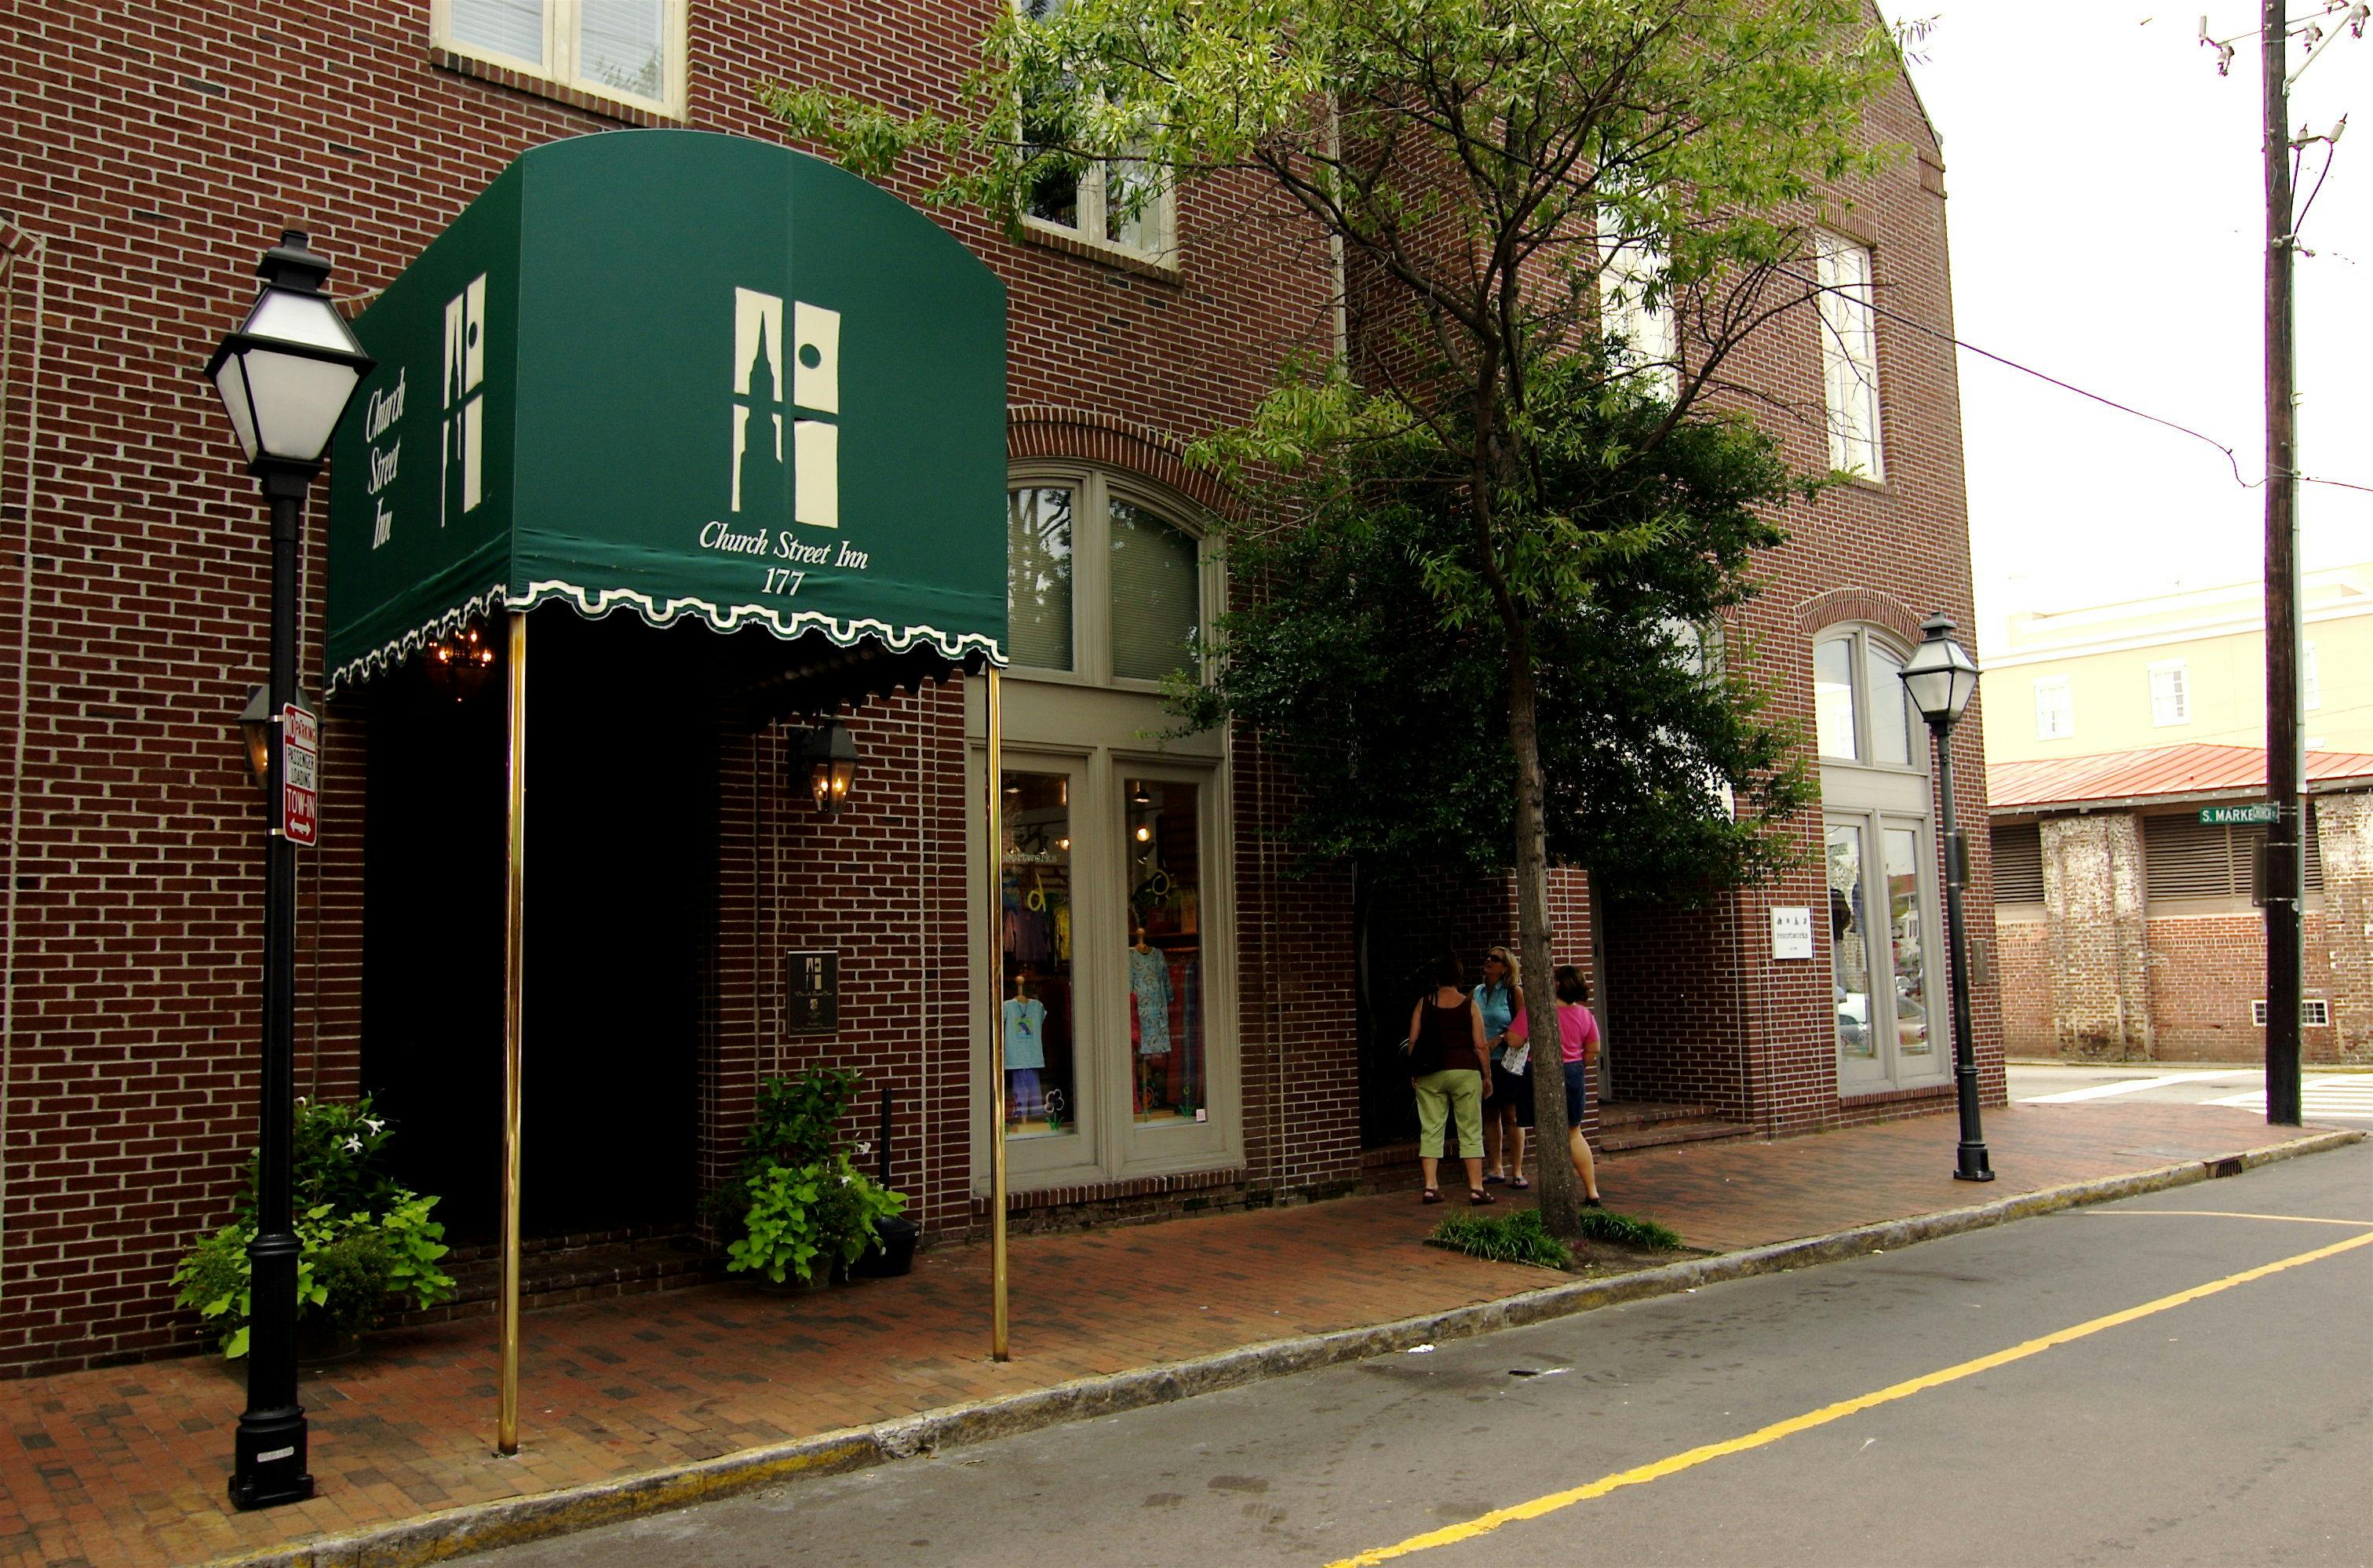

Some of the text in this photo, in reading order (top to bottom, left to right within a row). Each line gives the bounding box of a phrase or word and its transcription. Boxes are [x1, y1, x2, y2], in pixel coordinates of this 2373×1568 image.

[365, 366, 406, 443] Church
[367, 434, 401, 495] Street
[372, 496, 392, 550] Inn
[699, 520, 869, 570] Church Street Inn
[761, 567, 806, 596] 177
[286, 712, 315, 743] NO PARKING
[286, 788, 315, 819] TOW-IN
[2202, 808, 2254, 822] S. MARKE
